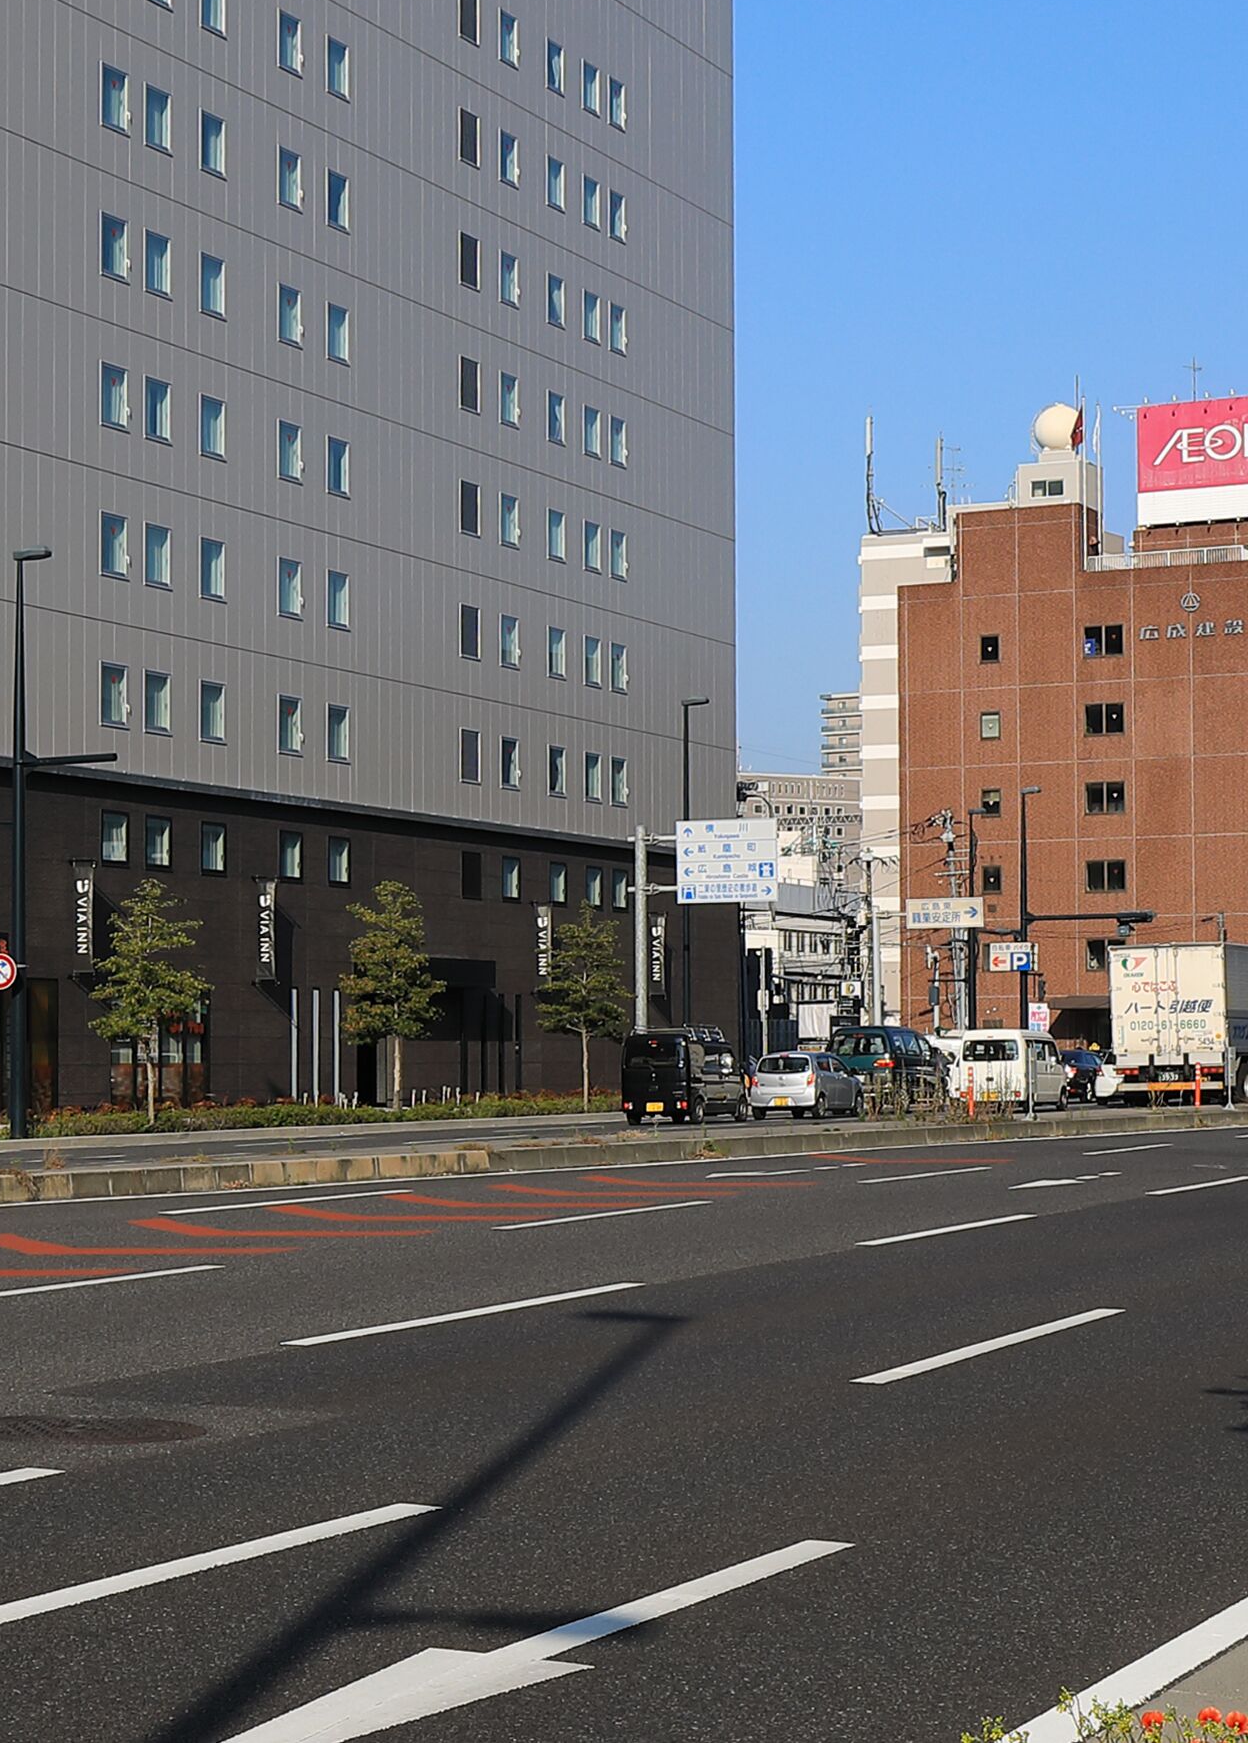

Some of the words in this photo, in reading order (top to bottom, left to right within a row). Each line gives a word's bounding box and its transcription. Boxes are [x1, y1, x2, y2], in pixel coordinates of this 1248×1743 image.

[1139, 619, 1244, 641] 広成建設
[77, 897, 88, 923] VIA
[260, 911, 270, 935] VIA
[77, 928, 88, 954] INN
[260, 938, 270, 963] INN
[652, 939, 661, 960] VIA
[538, 954, 548, 976] INN
[652, 961, 661, 981] INN
[1012, 954, 1027, 970] P
